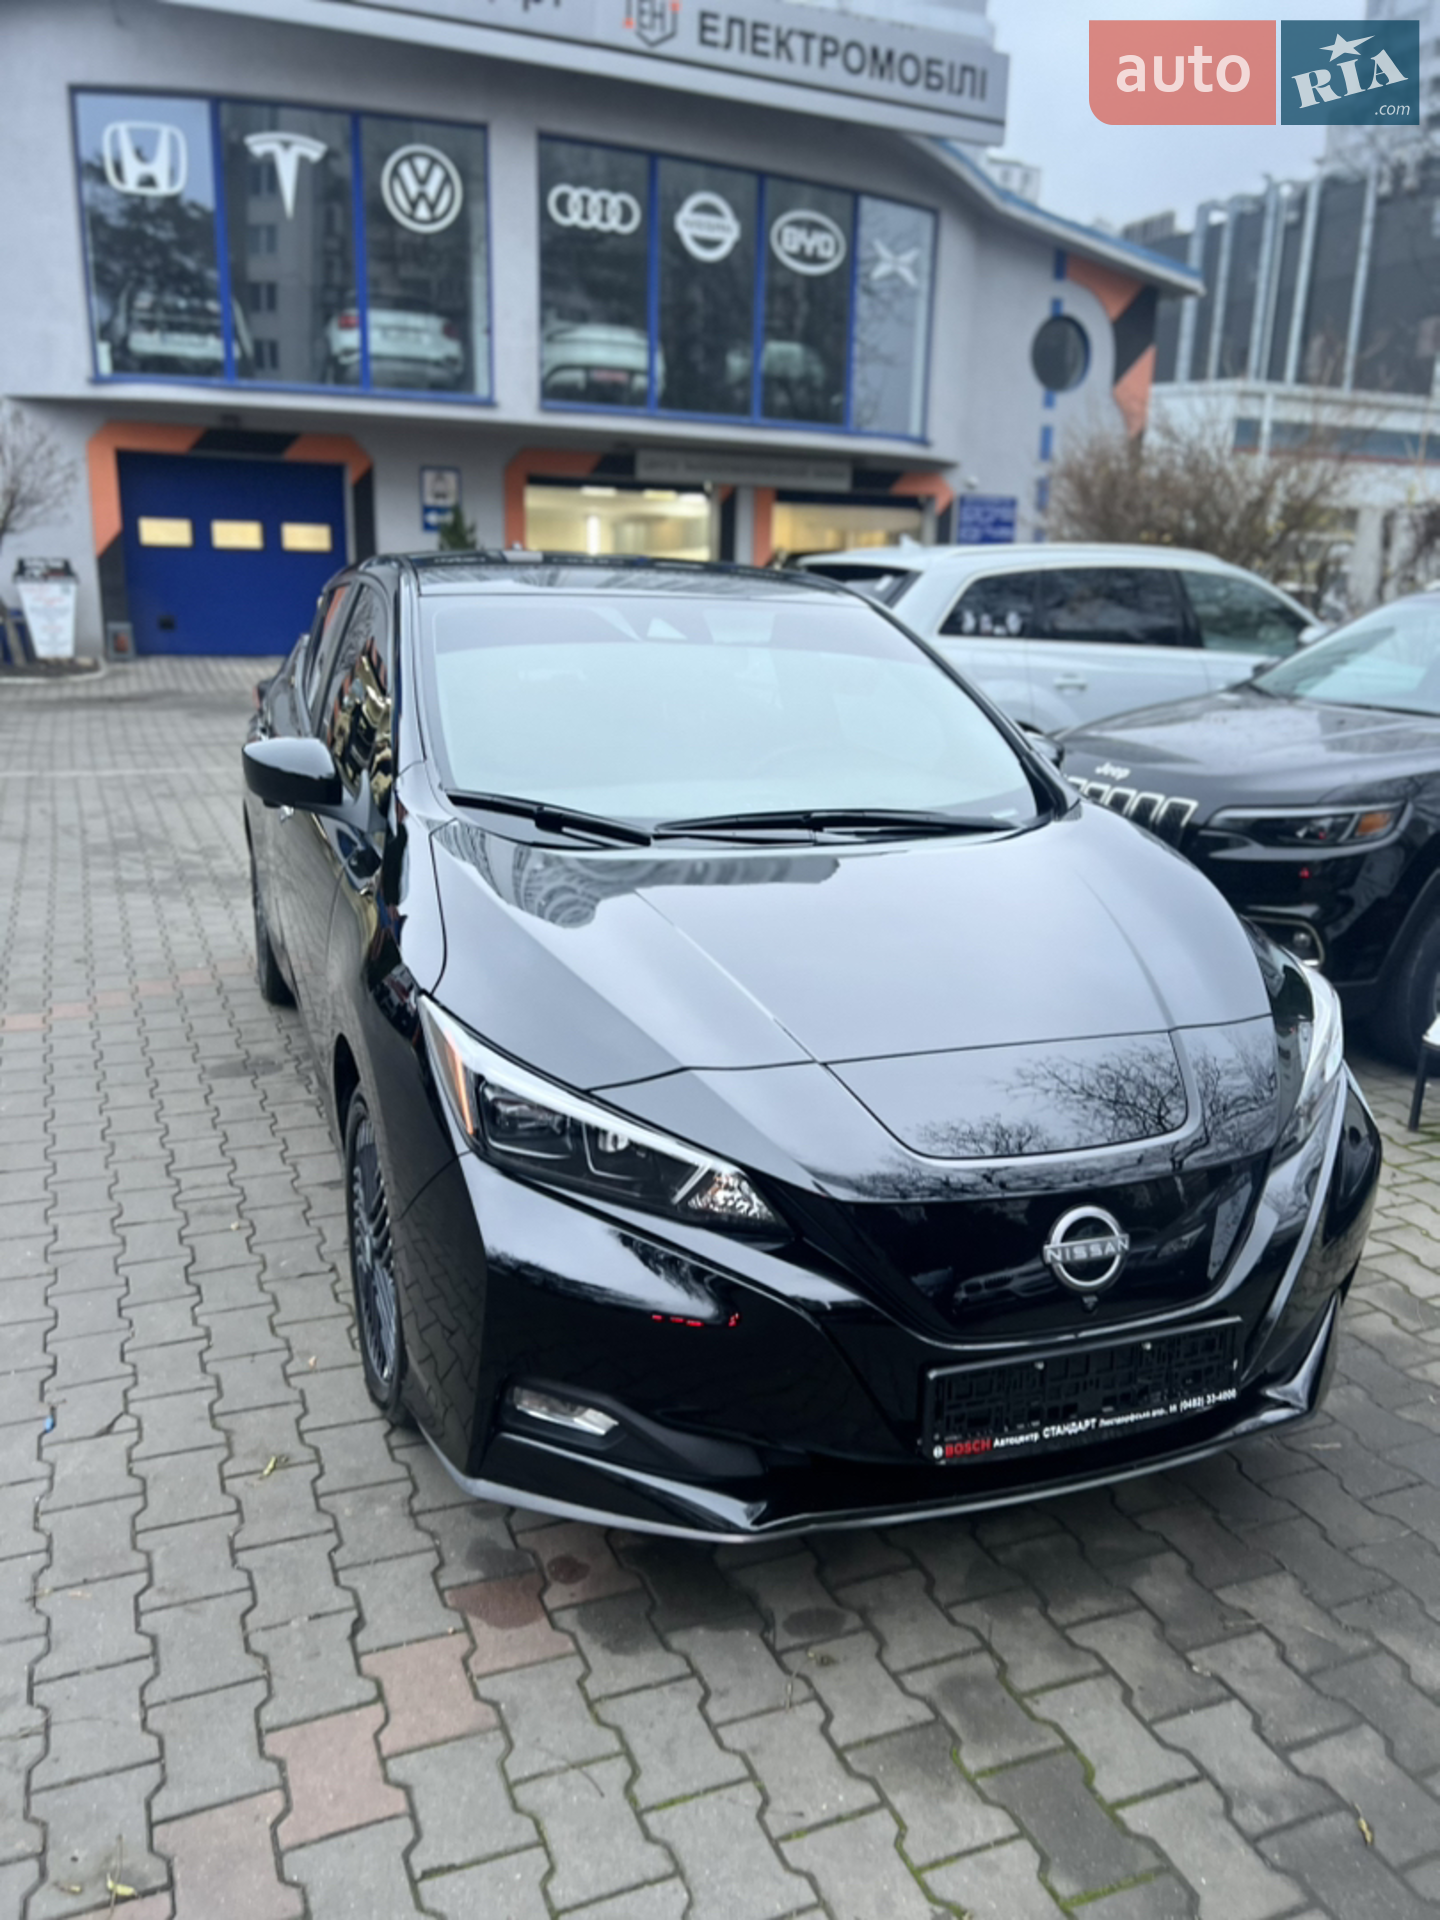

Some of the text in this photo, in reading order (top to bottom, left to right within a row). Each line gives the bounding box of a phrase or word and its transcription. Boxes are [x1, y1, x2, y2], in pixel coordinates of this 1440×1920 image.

[697, 9, 989, 102] ЕЛЕКТРОМОБІЛІ
[781, 224, 836, 260] BYD
[1045, 1235, 1129, 1263] NISSAN
[1042, 1418, 1097, 1439] СТАНДАРТ
[945, 1438, 993, 1459] BOSCH
